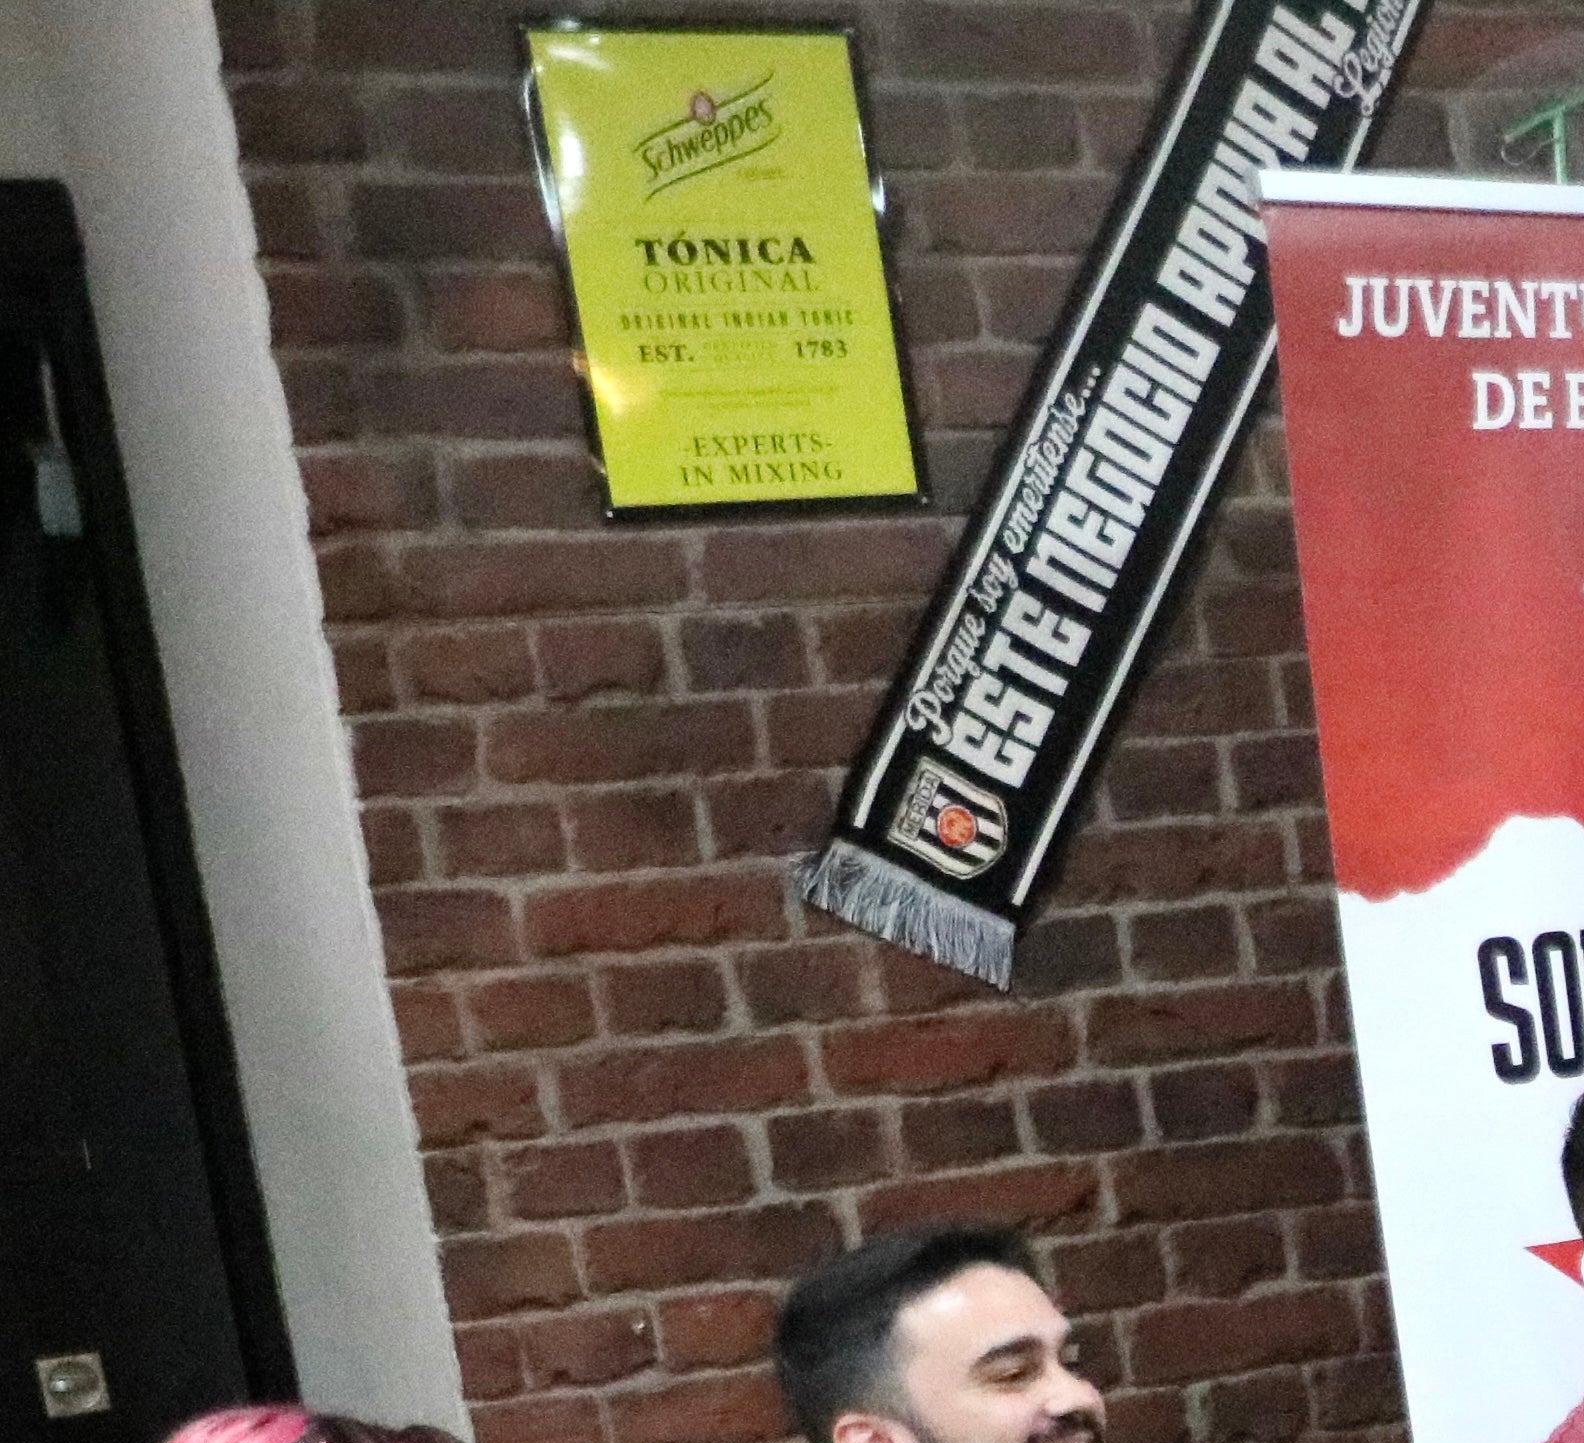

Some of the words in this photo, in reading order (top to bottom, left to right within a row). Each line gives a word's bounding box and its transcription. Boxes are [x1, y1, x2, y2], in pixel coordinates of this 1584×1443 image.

[641, 98, 774, 179] Schweppes
[635, 231, 817, 267] TÓNICA
[643, 268, 821, 296] ORIGINAL
[637, 343, 695, 364] EST.
[795, 338, 849, 359] 1783
[950, 598, 1092, 789] ESTE
[1028, 300, 1221, 614] NEGOCIO
[1255, 4, 1356, 110] AL
[1471, 371, 1554, 431] DE
[680, 466, 715, 488] IN
[729, 460, 843, 486] MIXING
[905, 606, 987, 748] Porque
